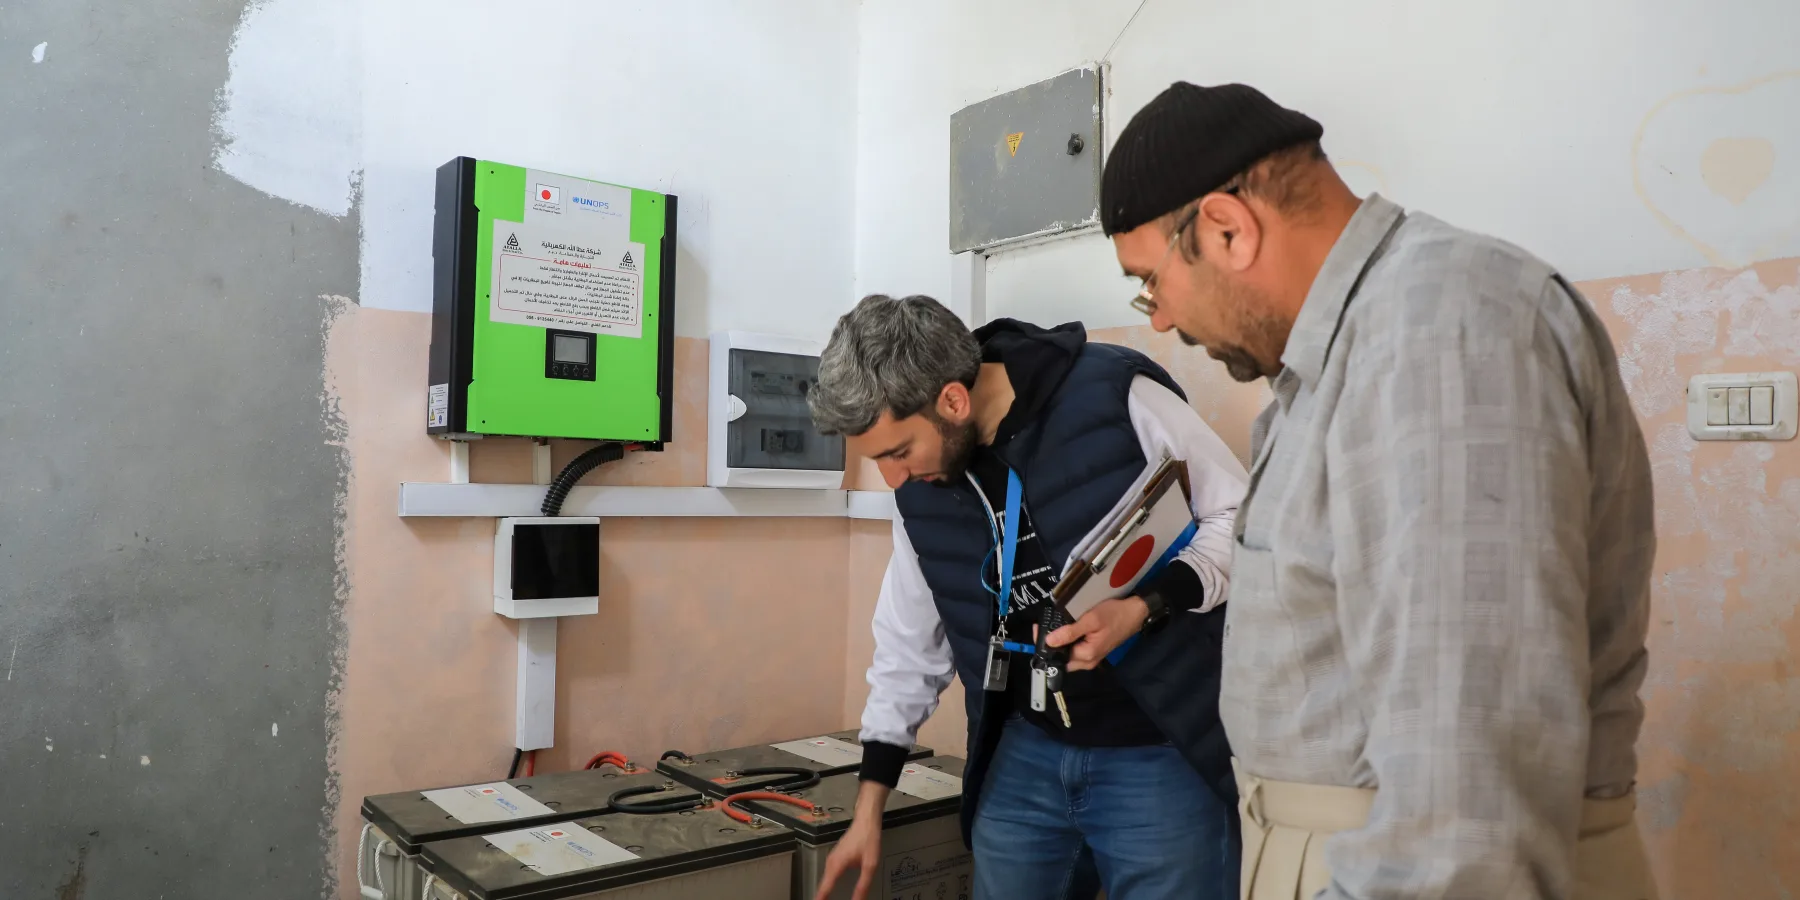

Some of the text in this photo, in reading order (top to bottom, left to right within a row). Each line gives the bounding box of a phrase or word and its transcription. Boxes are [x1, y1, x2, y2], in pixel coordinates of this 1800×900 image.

[580, 198, 609, 209] UNOPS
[541, 241, 566, 250] الكهربائية
[586, 247, 601, 255] شركة
